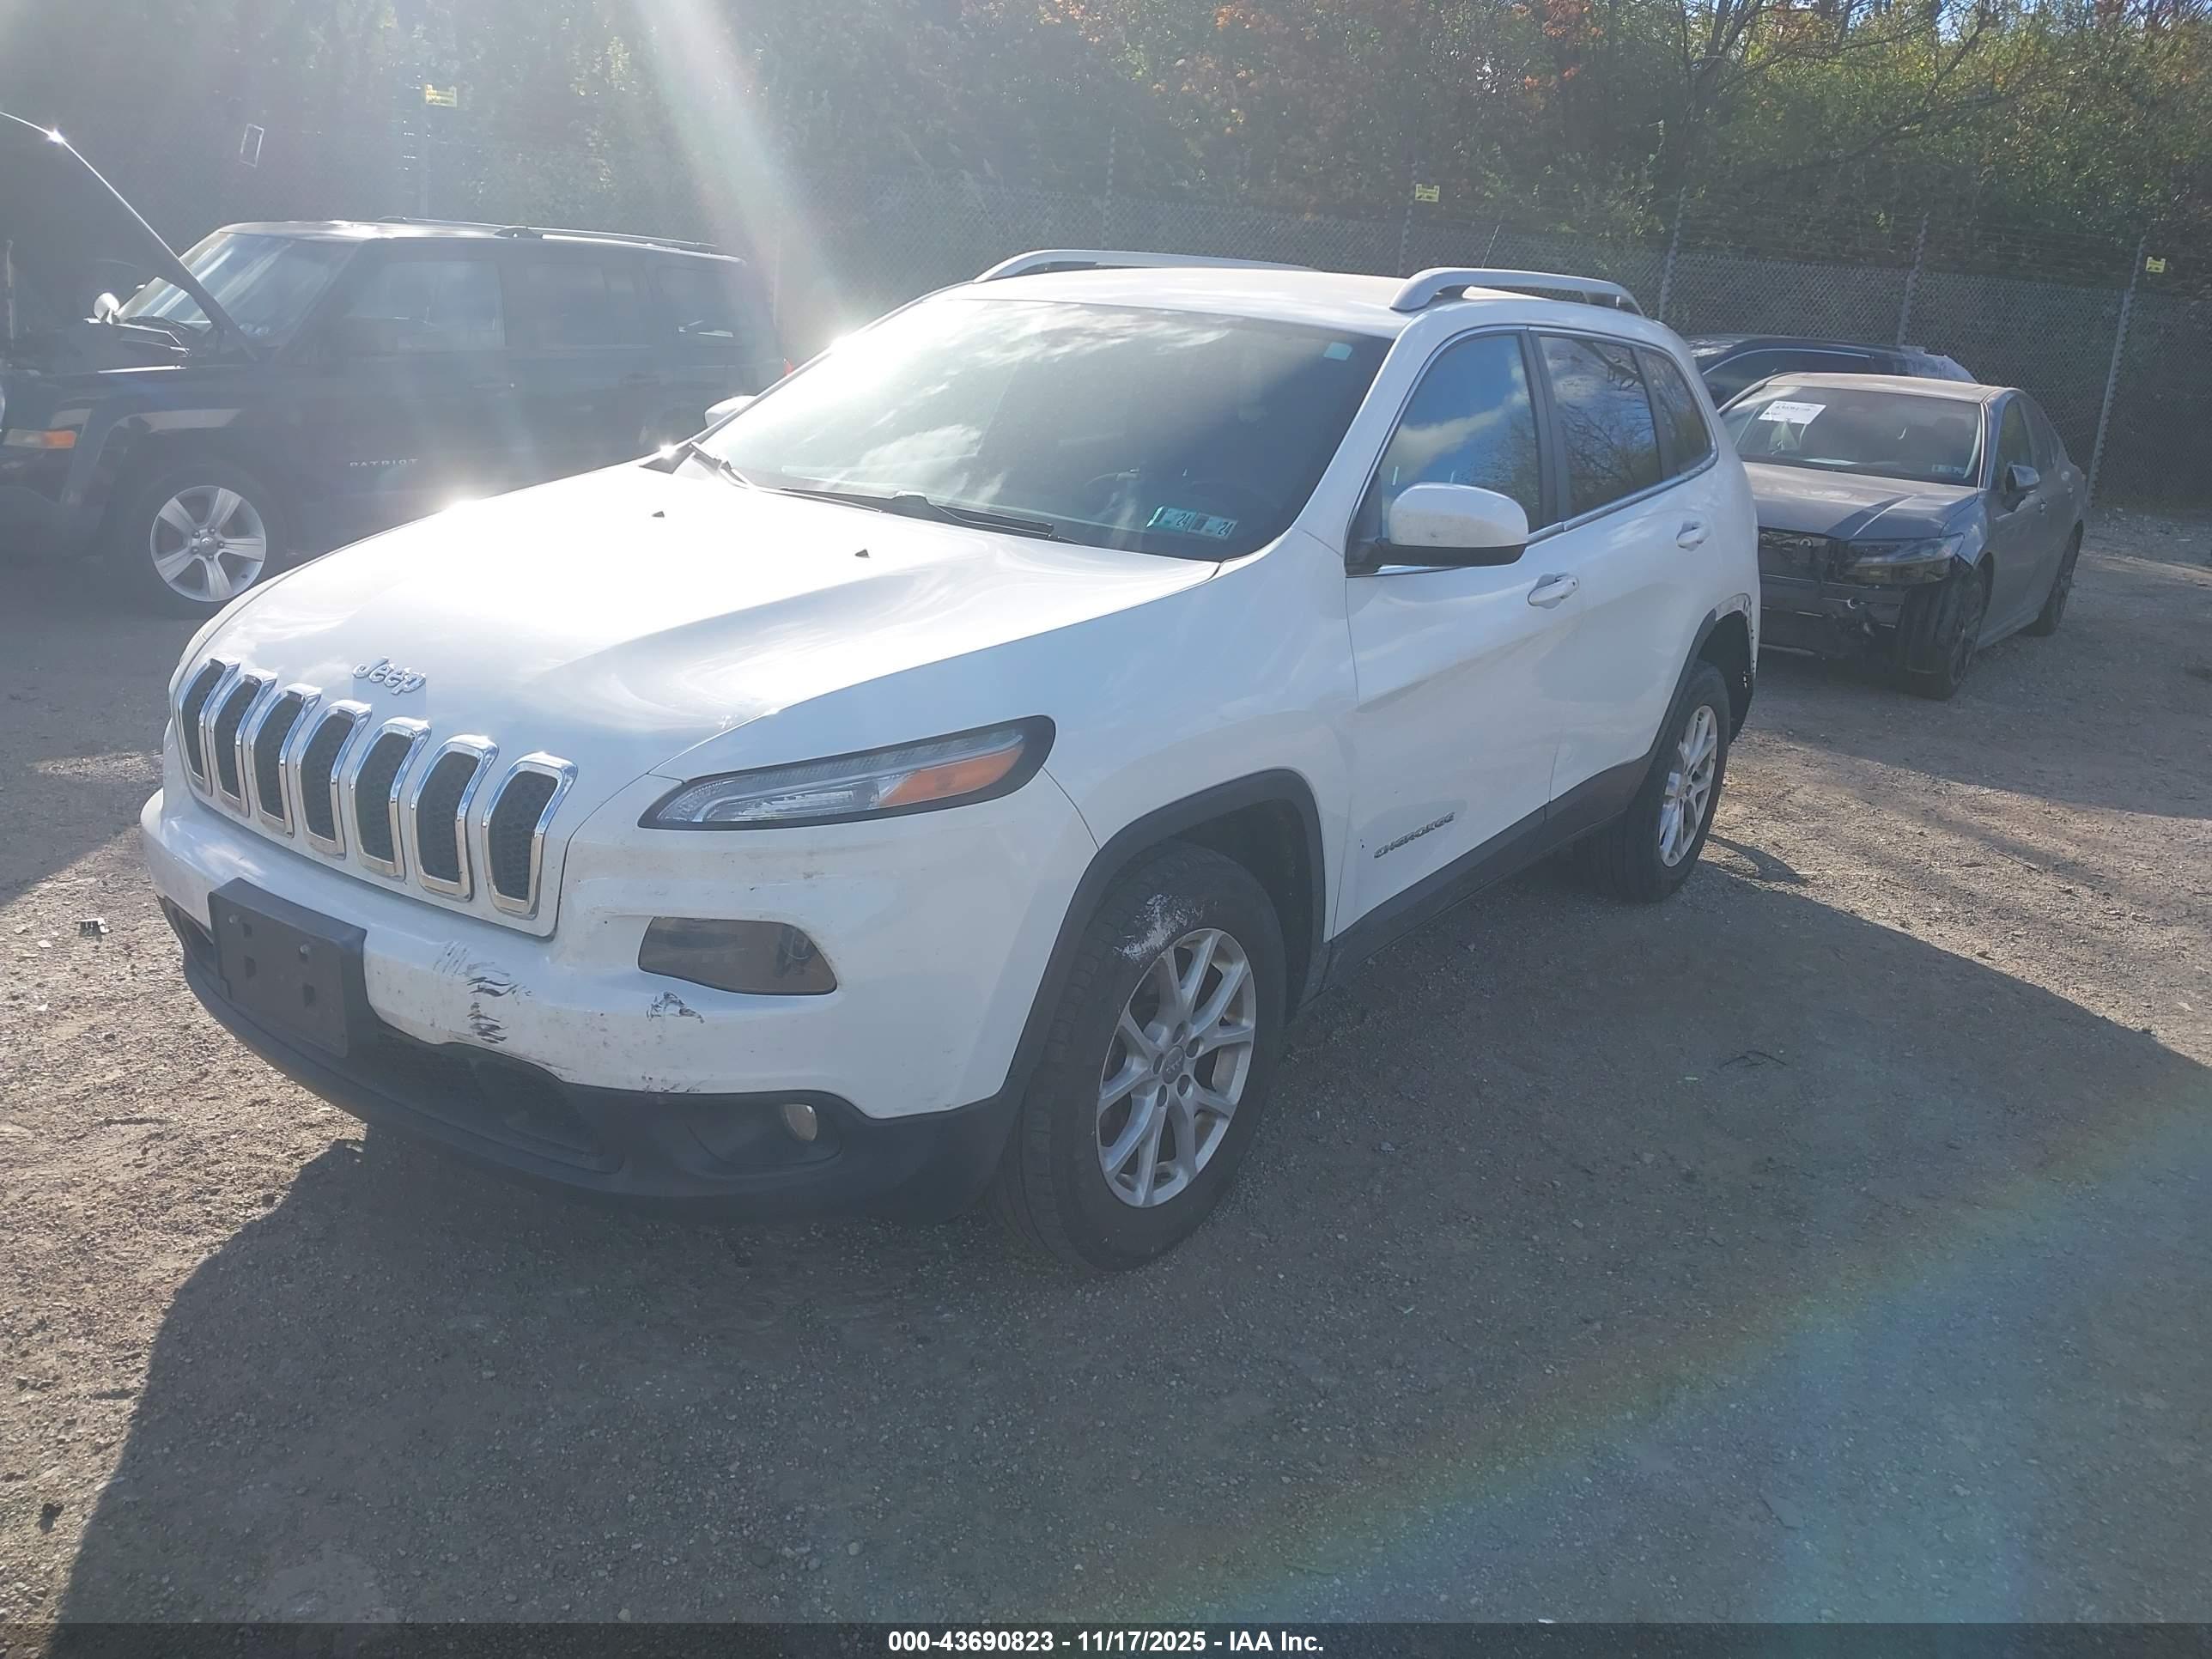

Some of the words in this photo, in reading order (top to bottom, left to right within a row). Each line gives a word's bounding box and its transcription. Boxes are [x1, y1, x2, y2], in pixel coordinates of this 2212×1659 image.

[349, 459, 419, 467] PATRIOT
[1176, 513, 1192, 528] 24
[1217, 521, 1234, 537] 24
[351, 655, 426, 696] Jeep
[1374, 811, 1455, 859] CHEROKEE
